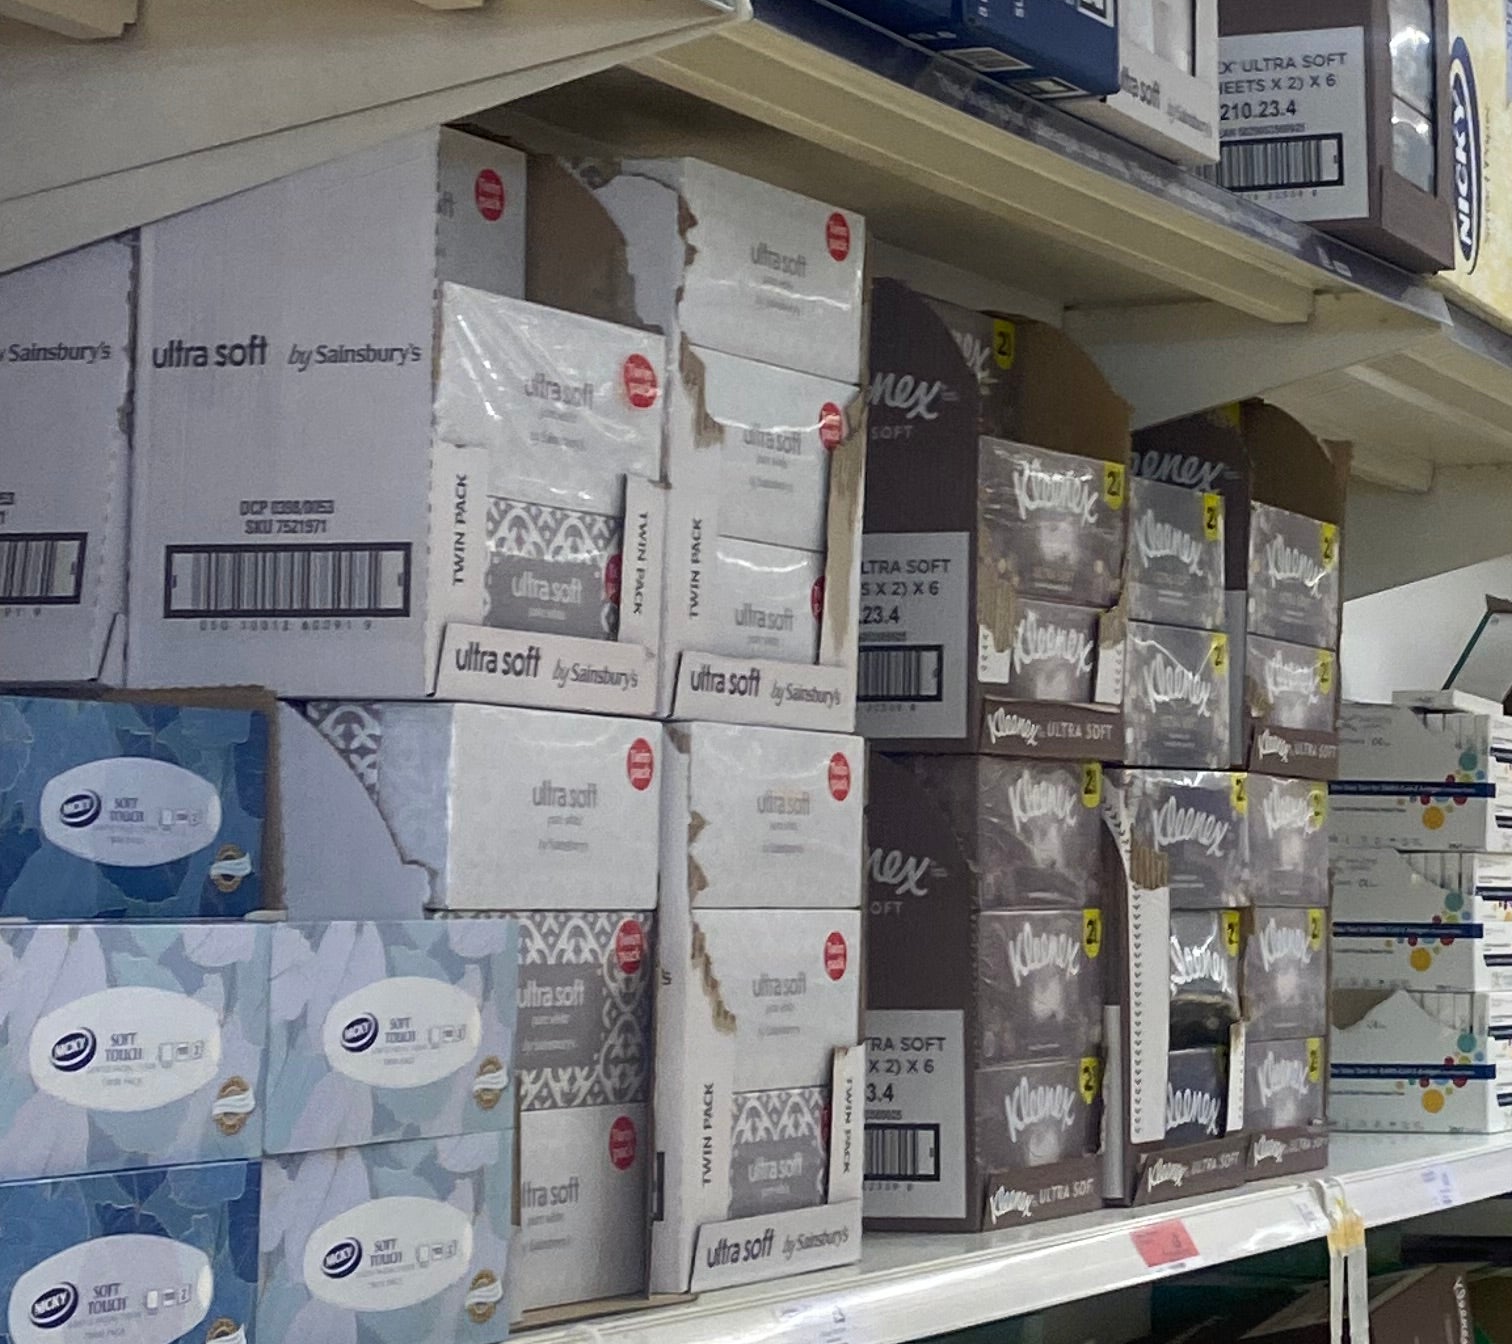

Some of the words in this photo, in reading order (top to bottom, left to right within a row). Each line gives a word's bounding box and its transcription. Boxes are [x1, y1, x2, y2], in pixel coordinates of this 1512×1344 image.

[1244, 57, 1297, 73] ULTRA
[1302, 52, 1347, 68] SOFT
[1327, 74, 1337, 87] 6
[1451, 74, 1474, 246] NICKY
[11, 340, 111, 363] Sainsbury's
[153, 338, 208, 369] ultra
[214, 335, 268, 366] soft
[288, 343, 312, 372] by
[315, 339, 421, 366] Sainsbury's
[872, 424, 912, 441] SOFT
[454, 472, 468, 524] PACK
[638, 511, 649, 564] TWIN
[690, 518, 703, 564] PACK
[1135, 509, 1203, 576] Kleenex
[453, 531, 465, 587] TWIN
[906, 558, 951, 574] SOFT
[511, 574, 548, 600] ultra
[550, 577, 582, 605] soft
[632, 567, 647, 616] PACK
[689, 568, 700, 618] TWIN
[929, 581, 940, 595] 6
[1014, 611, 1094, 675] Kleenex
[455, 641, 498, 674] ultra
[501, 644, 540, 678] soft
[552, 659, 570, 687] by
[571, 659, 638, 689] Sainsbury's
[690, 668, 725, 695] ultra
[728, 668, 761, 697] soft
[1144, 655, 1210, 717] Kleenex
[988, 709, 1038, 746] Kleenex
[1047, 721, 1083, 739] ULTRA
[532, 780, 566, 808] ultra
[567, 782, 598, 808] soft
[1154, 795, 1230, 855] Kleenex
[553, 980, 585, 1007] soft
[105, 1047, 144, 1063] TOUCH
[901, 1036, 946, 1053] SOFT
[923, 1059, 934, 1074] 6
[702, 1082, 715, 1132] PACK
[1005, 1077, 1076, 1142] Kleenex
[702, 1137, 713, 1186] TWIN
[550, 1176, 580, 1205] soft
[990, 1185, 1032, 1225] Kleenex
[706, 1235, 740, 1267] ultra
[742, 1227, 775, 1261] soft
[88, 1297, 127, 1315] TOUCH
[93, 1282, 122, 1299] SOFT
